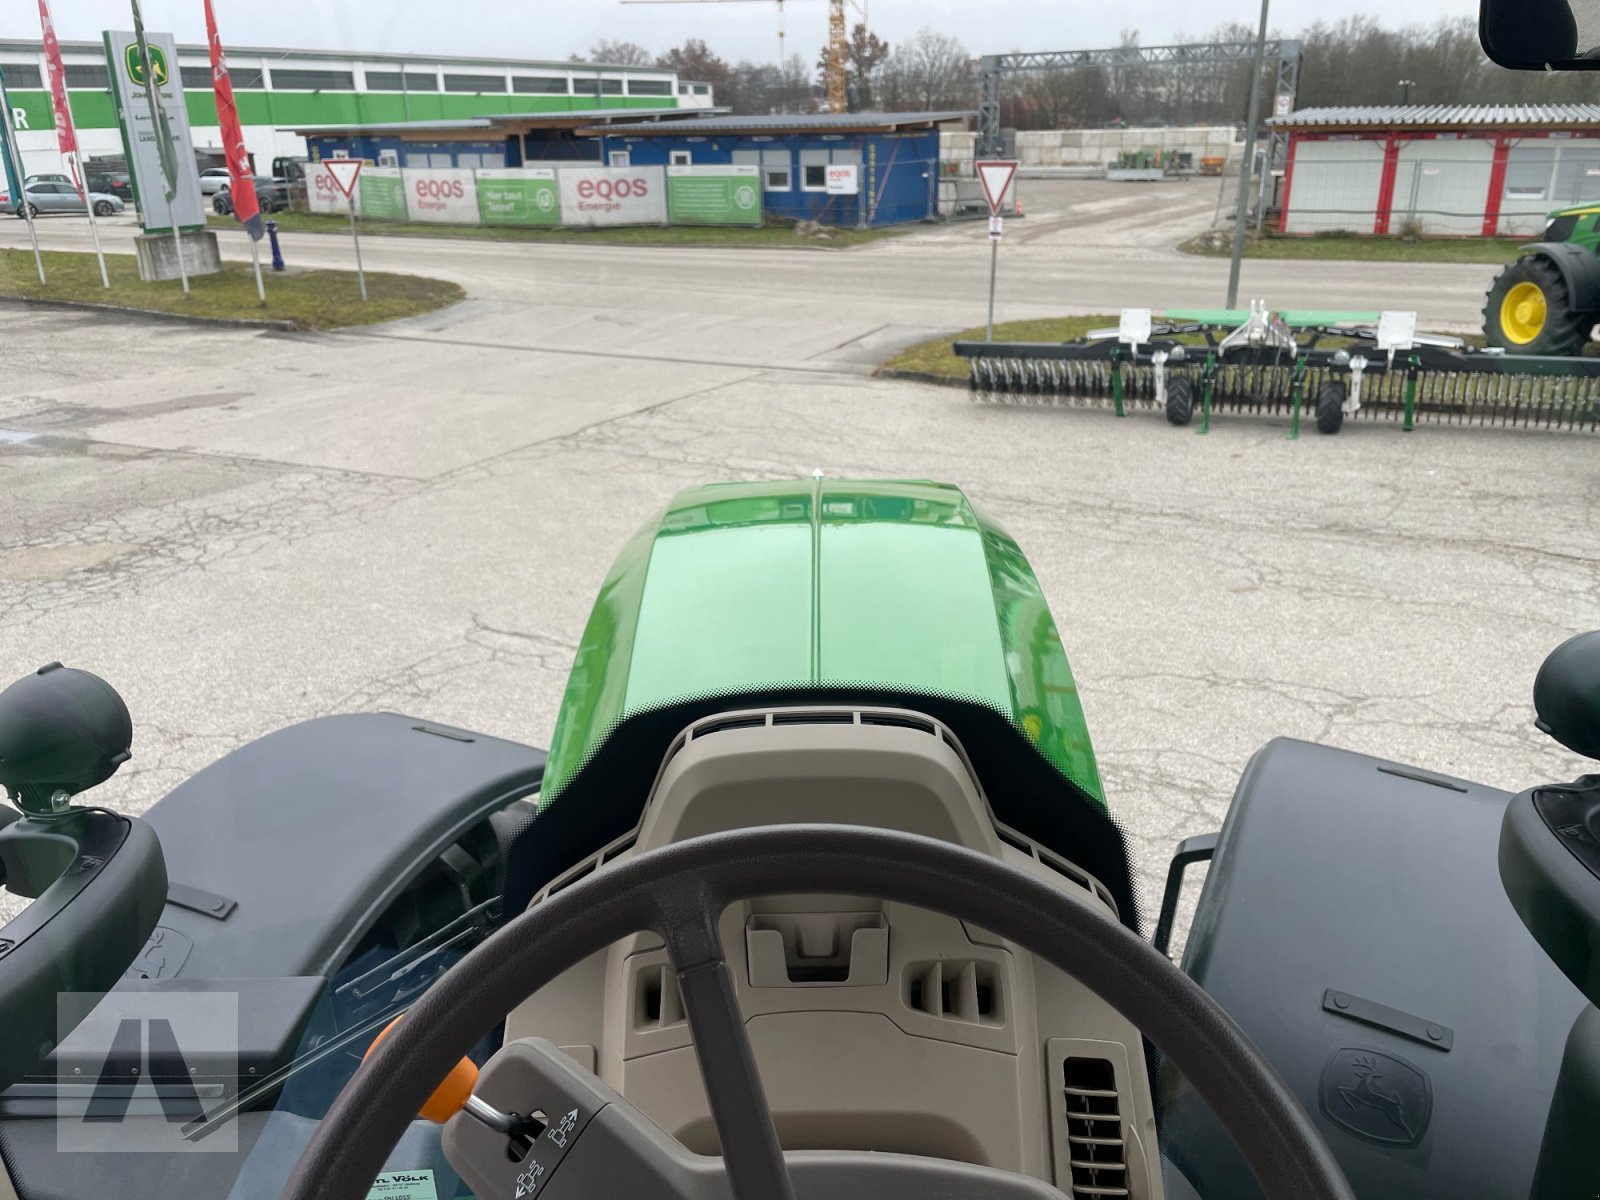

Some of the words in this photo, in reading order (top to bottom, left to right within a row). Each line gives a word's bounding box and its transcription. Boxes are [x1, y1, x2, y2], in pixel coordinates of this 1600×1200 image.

[416, 179, 464, 201] eqos
[577, 178, 648, 201] eqos
[578, 201, 621, 213] Energie
